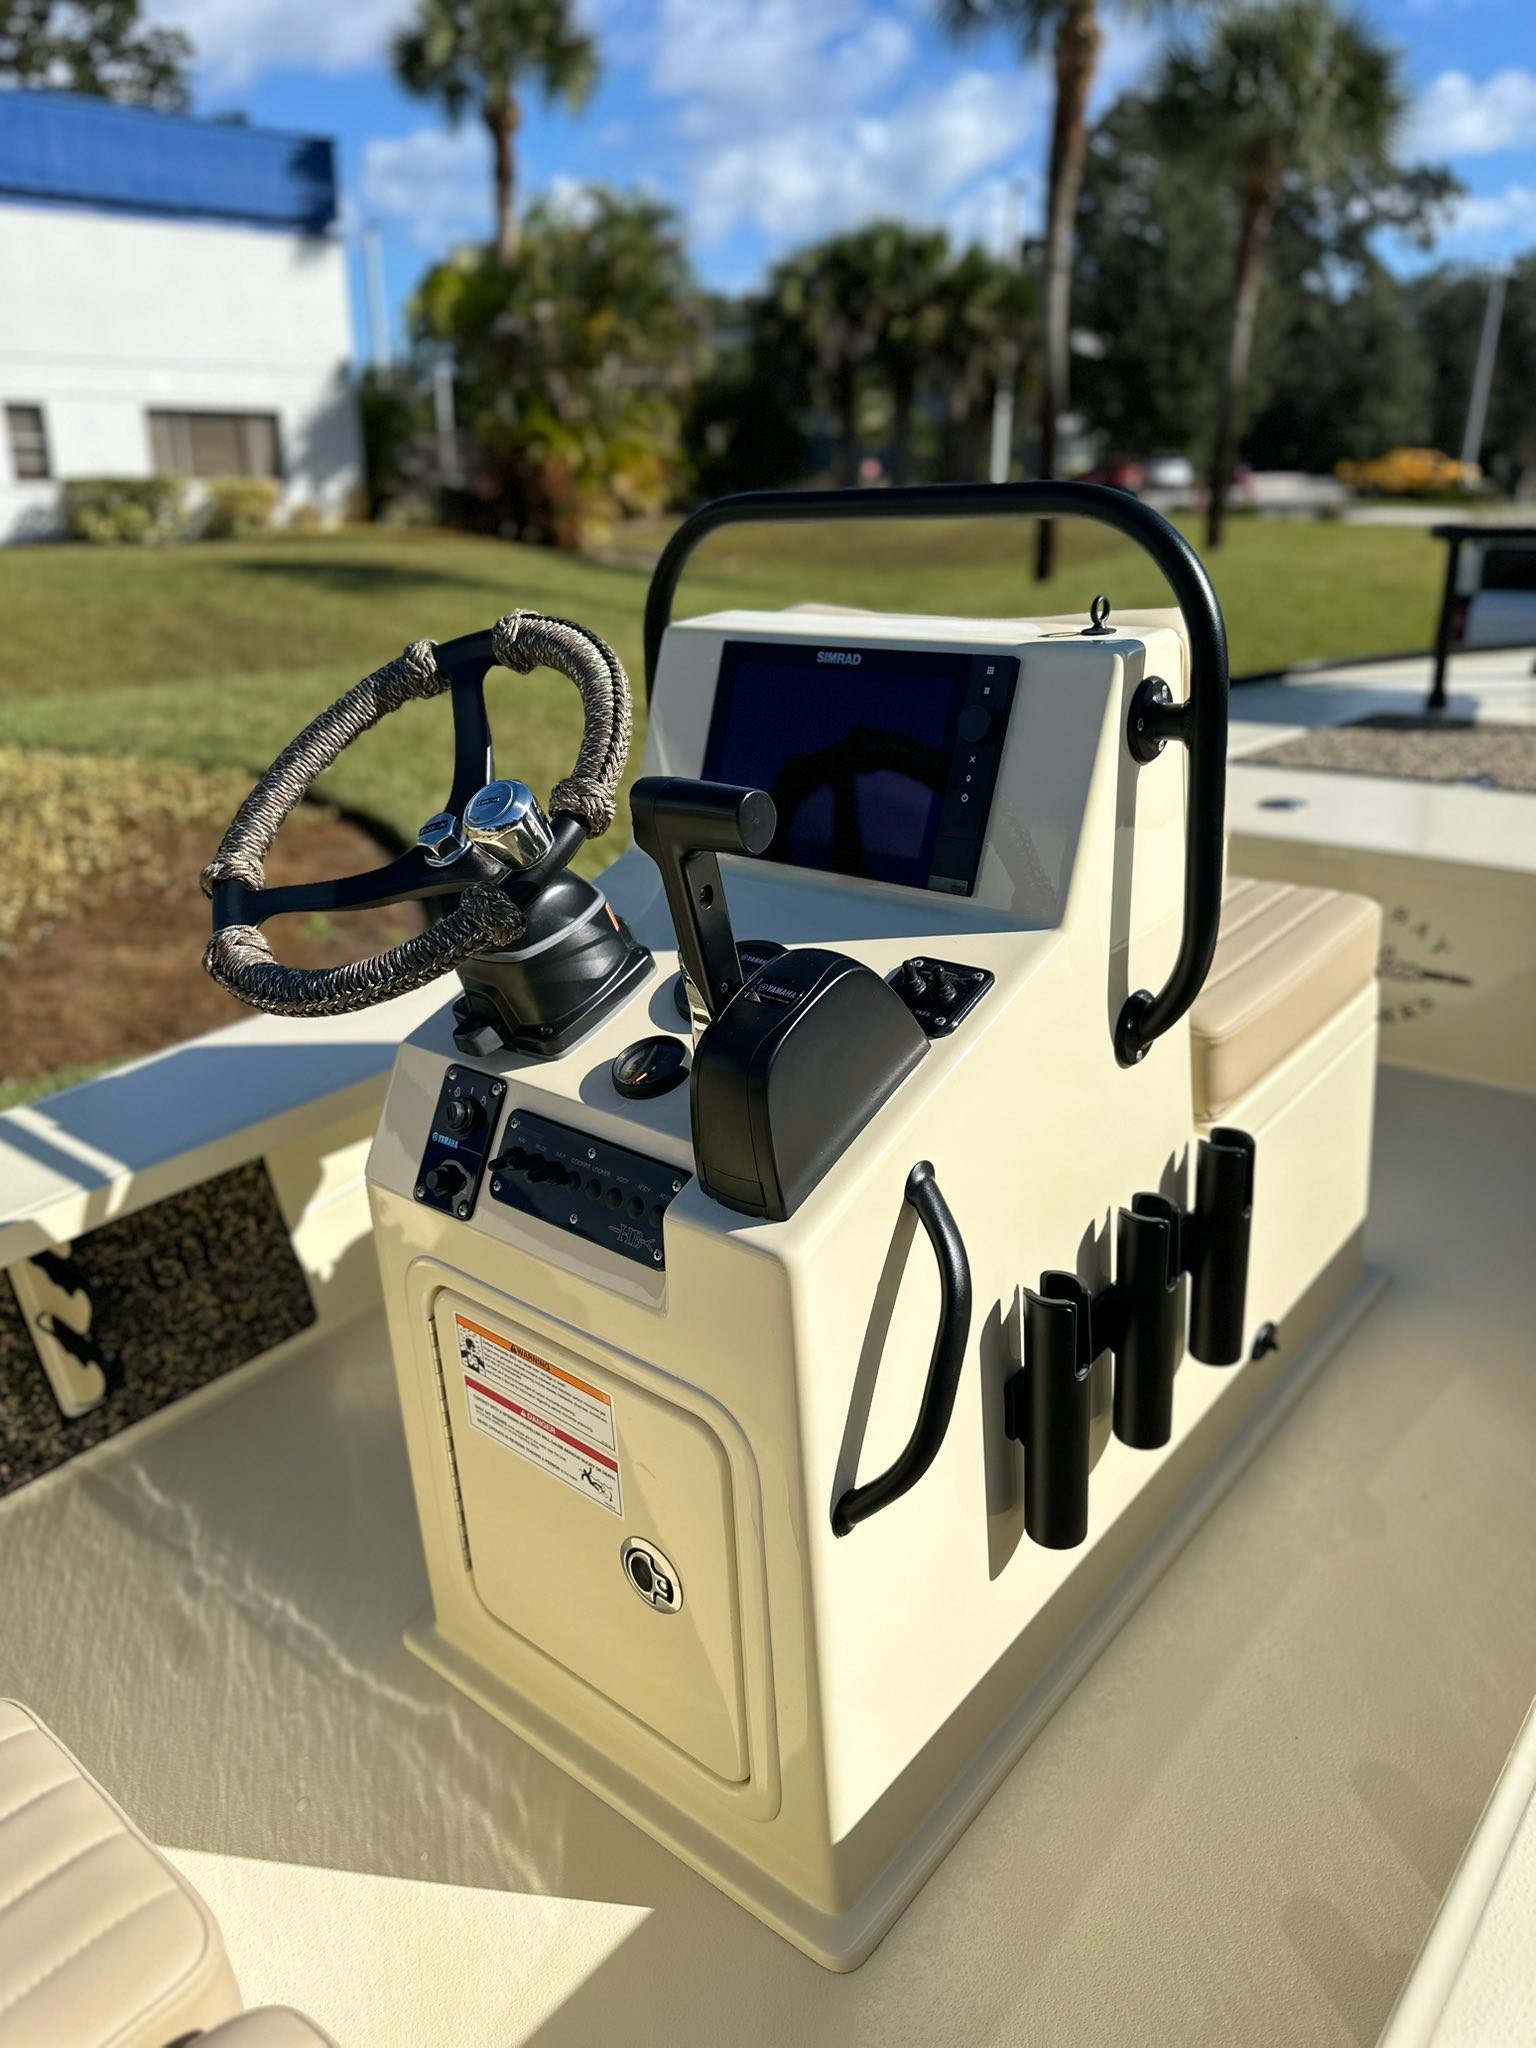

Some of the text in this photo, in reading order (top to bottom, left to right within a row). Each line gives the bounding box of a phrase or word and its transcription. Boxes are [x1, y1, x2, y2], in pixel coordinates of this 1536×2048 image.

[816, 650, 862, 666] SIMRAD
[767, 984, 797, 999] YAMAHA
[438, 1134, 459, 1150] YAMAHA
[592, 1165, 612, 1177] LOCKER
[515, 1348, 551, 1371] WARNING
[526, 1413, 556, 1435] DANGER
